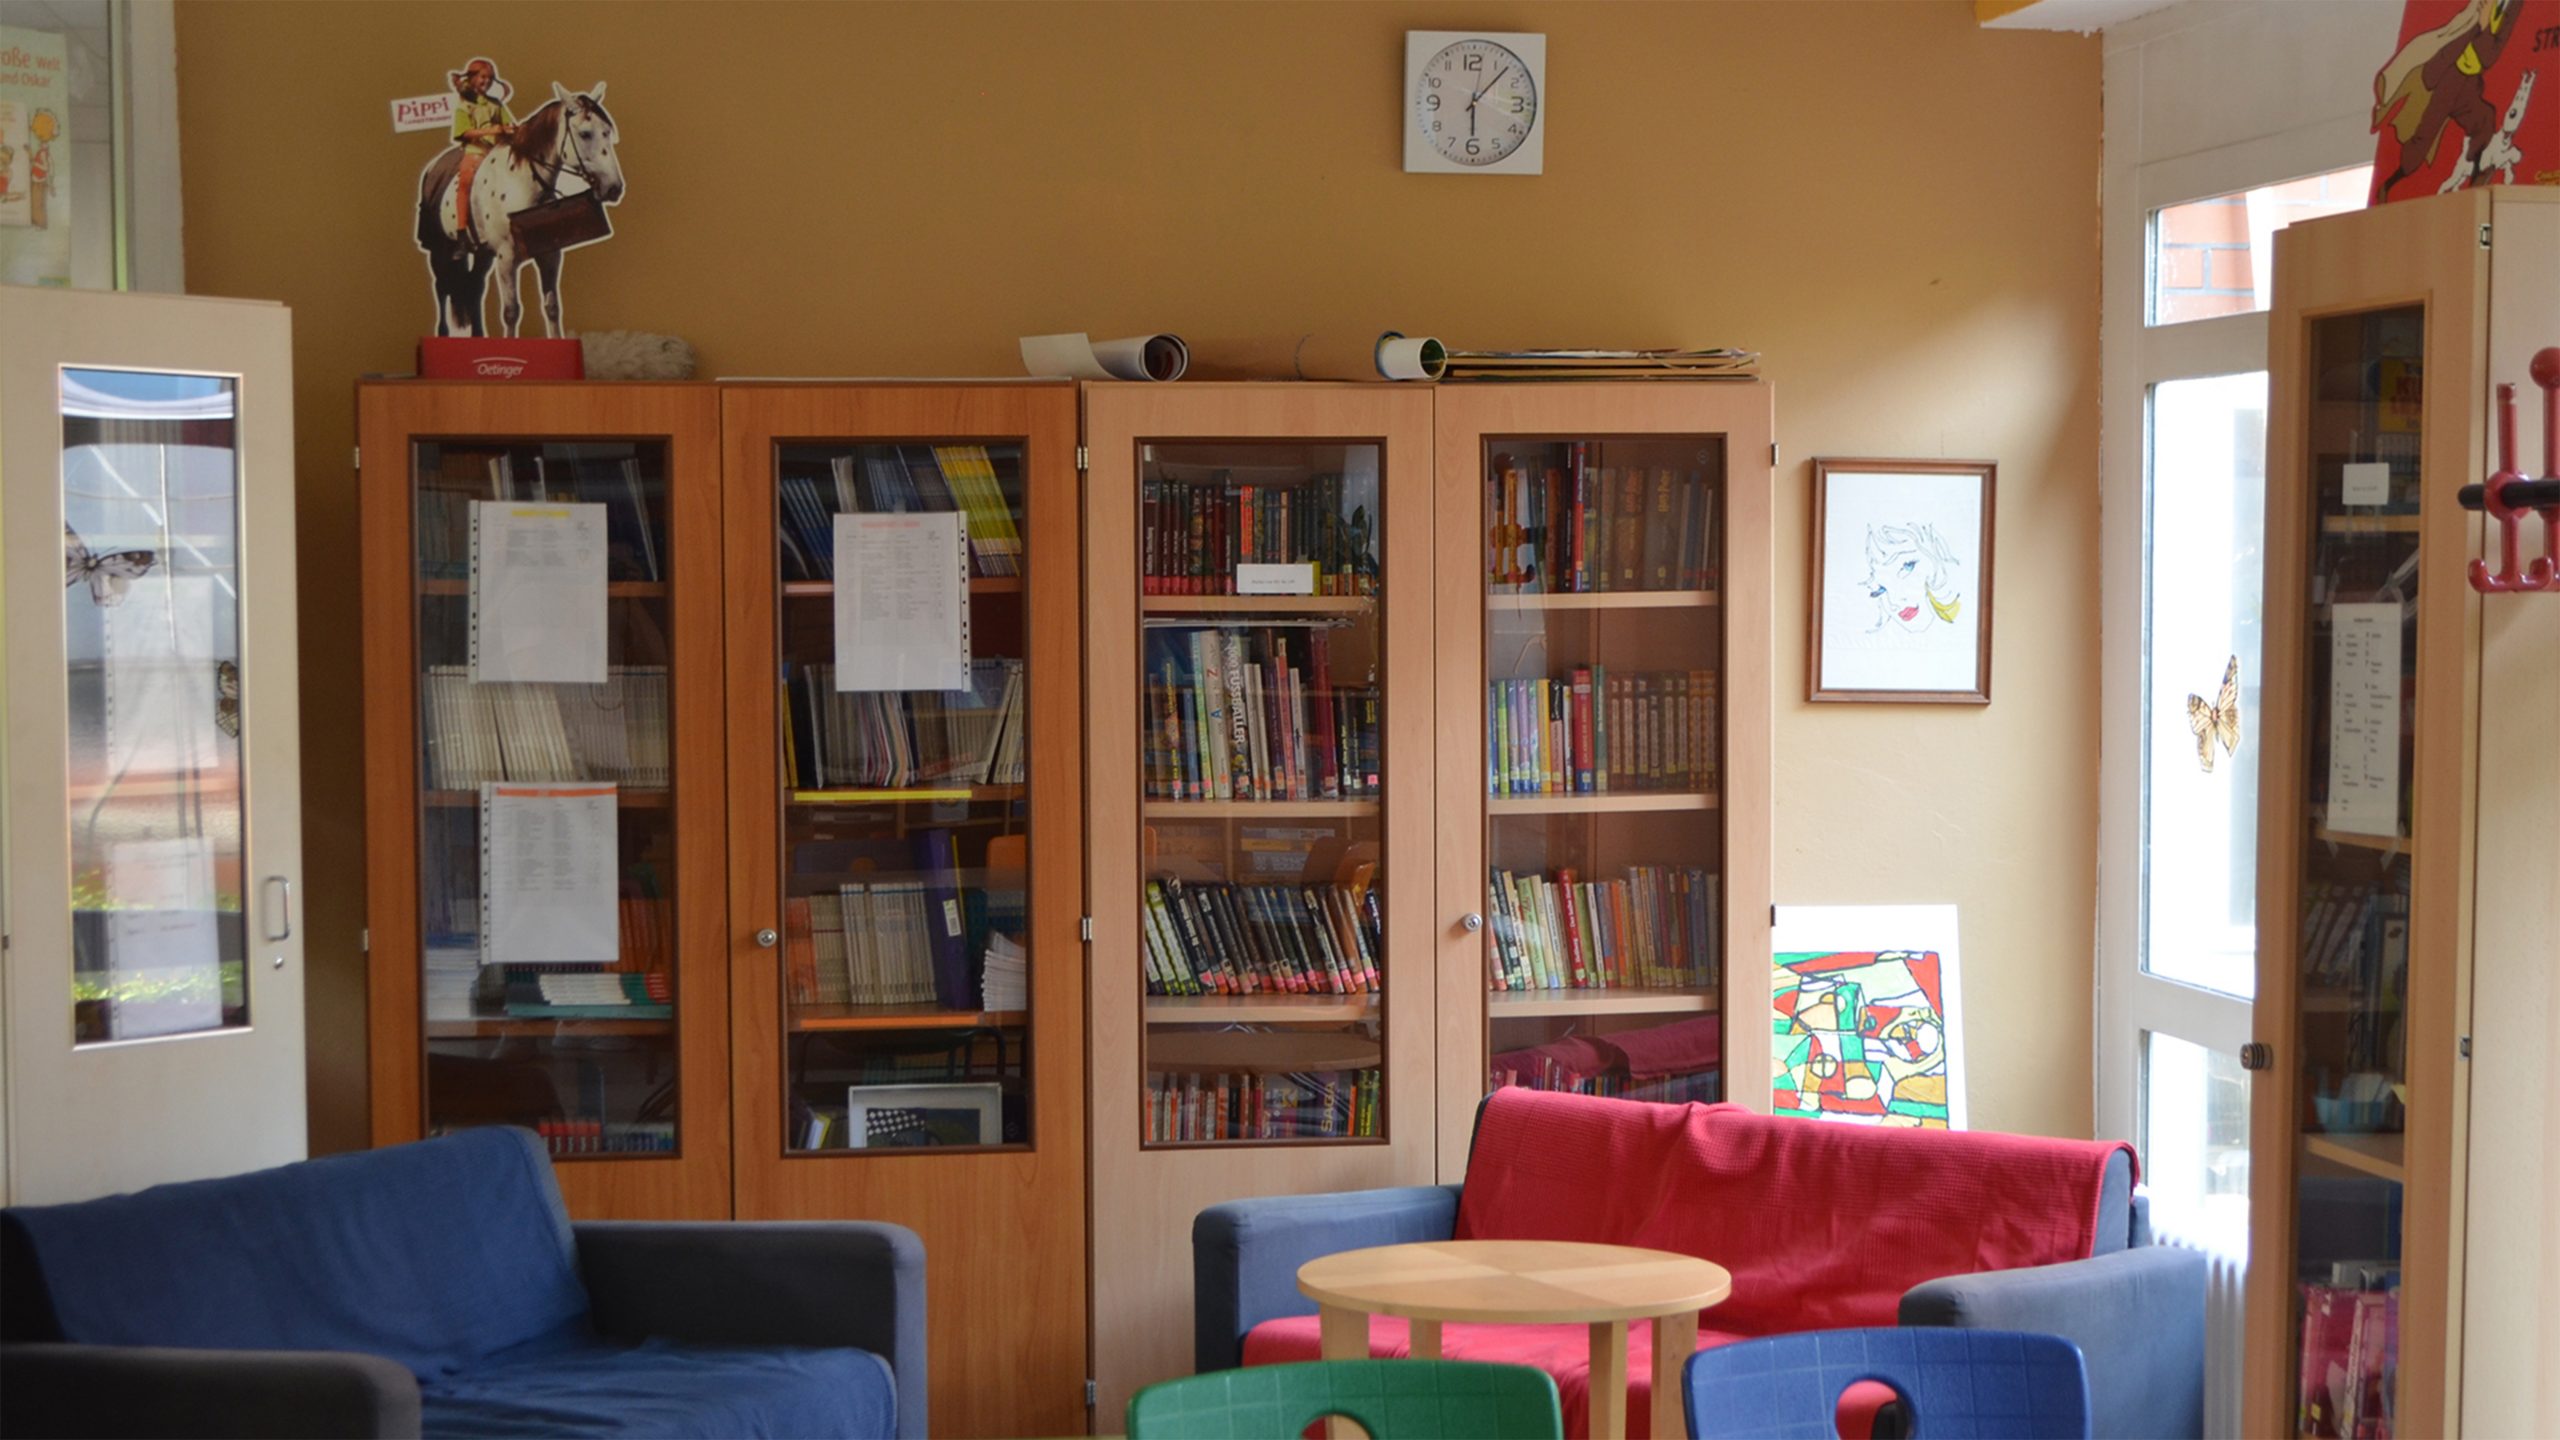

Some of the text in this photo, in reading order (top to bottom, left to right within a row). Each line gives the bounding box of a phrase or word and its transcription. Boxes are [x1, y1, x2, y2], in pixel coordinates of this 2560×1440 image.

[0, 47, 31, 69] oße
[1444, 60, 1452, 72] 11
[1463, 54, 1483, 72] 12
[1428, 78, 1442, 89] 10
[1510, 77, 1520, 89] 2
[1426, 94, 1441, 112] 9
[1511, 96, 1525, 114] 3
[1432, 120, 1442, 132] 8
[1507, 123, 1517, 134] 4
[1448, 136, 1456, 148] 7
[1465, 138, 1480, 156] 6
[1492, 138, 1501, 150] 5
[477, 362, 524, 379] Oetinger
[1229, 669, 1246, 743] FUSSBALLER
[1321, 1082, 1335, 1132] SAGA
